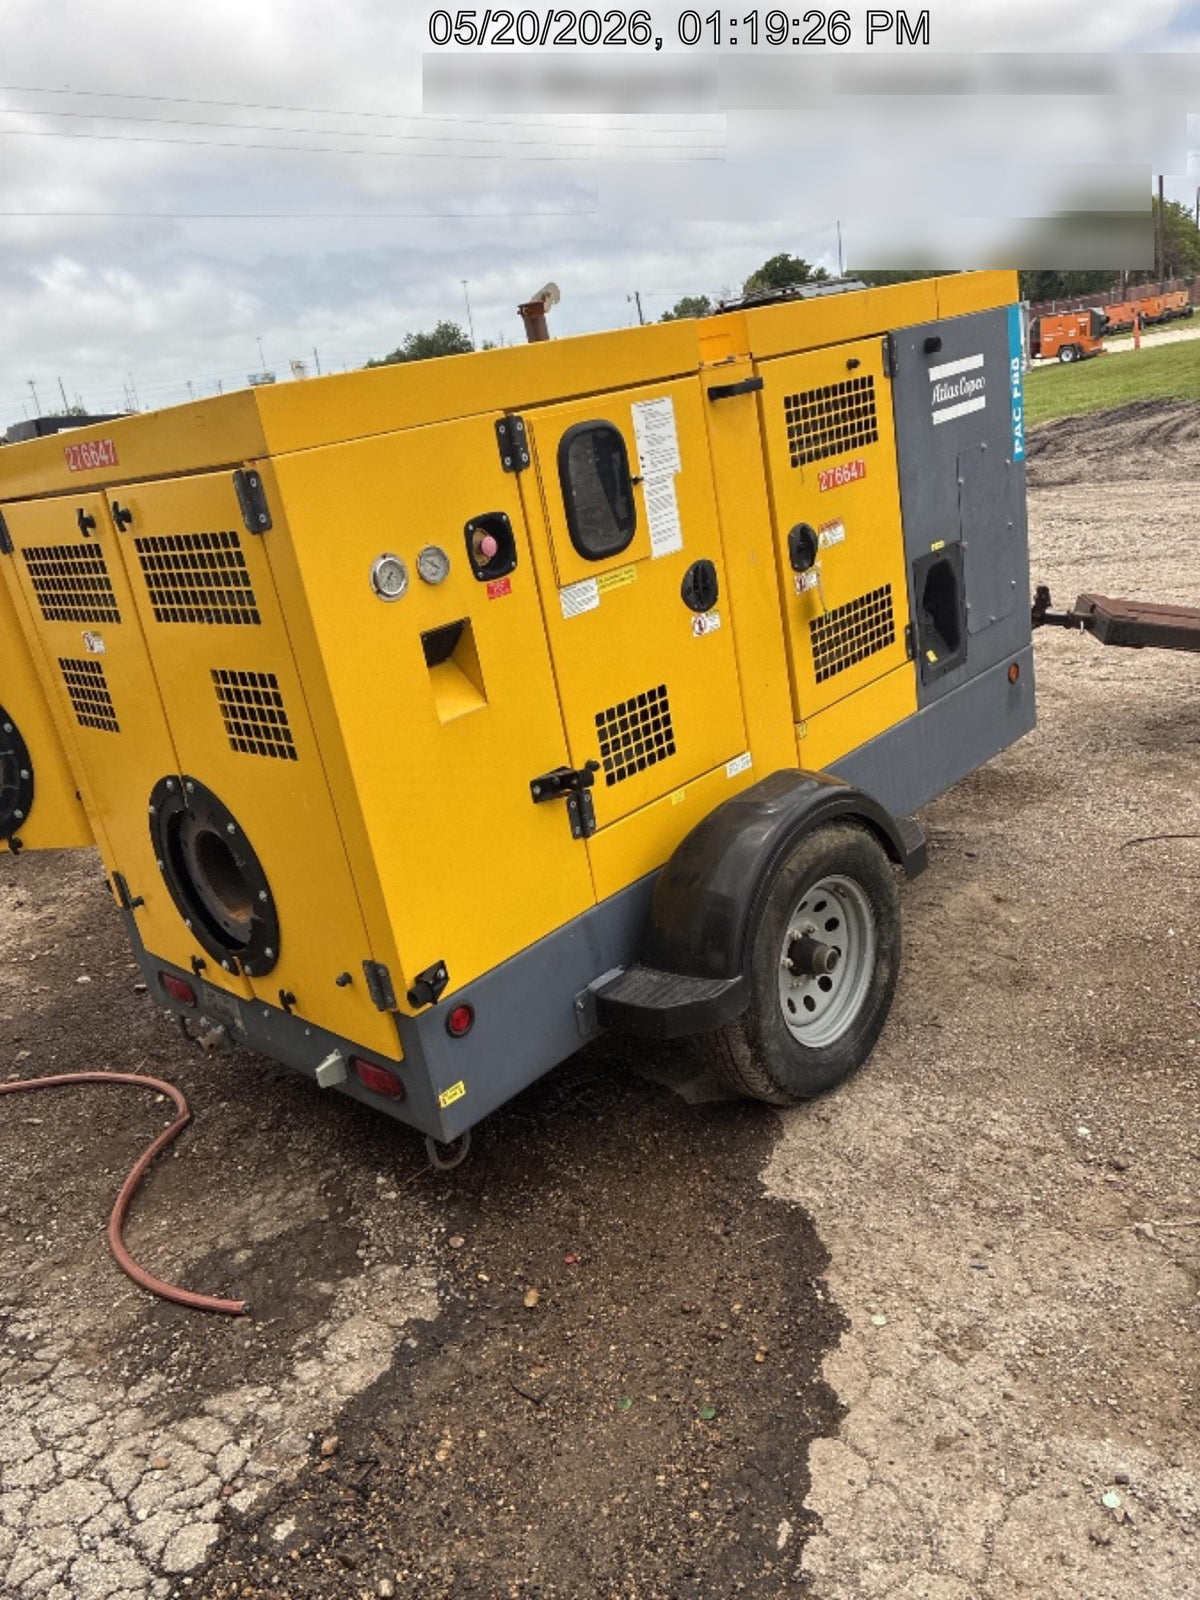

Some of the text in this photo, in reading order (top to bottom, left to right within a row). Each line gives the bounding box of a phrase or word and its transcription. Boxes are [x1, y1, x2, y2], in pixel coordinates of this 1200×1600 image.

[931, 376, 986, 405] Atlas Copco
[65, 439, 115, 470] 276647
[819, 460, 865, 491] 276647
